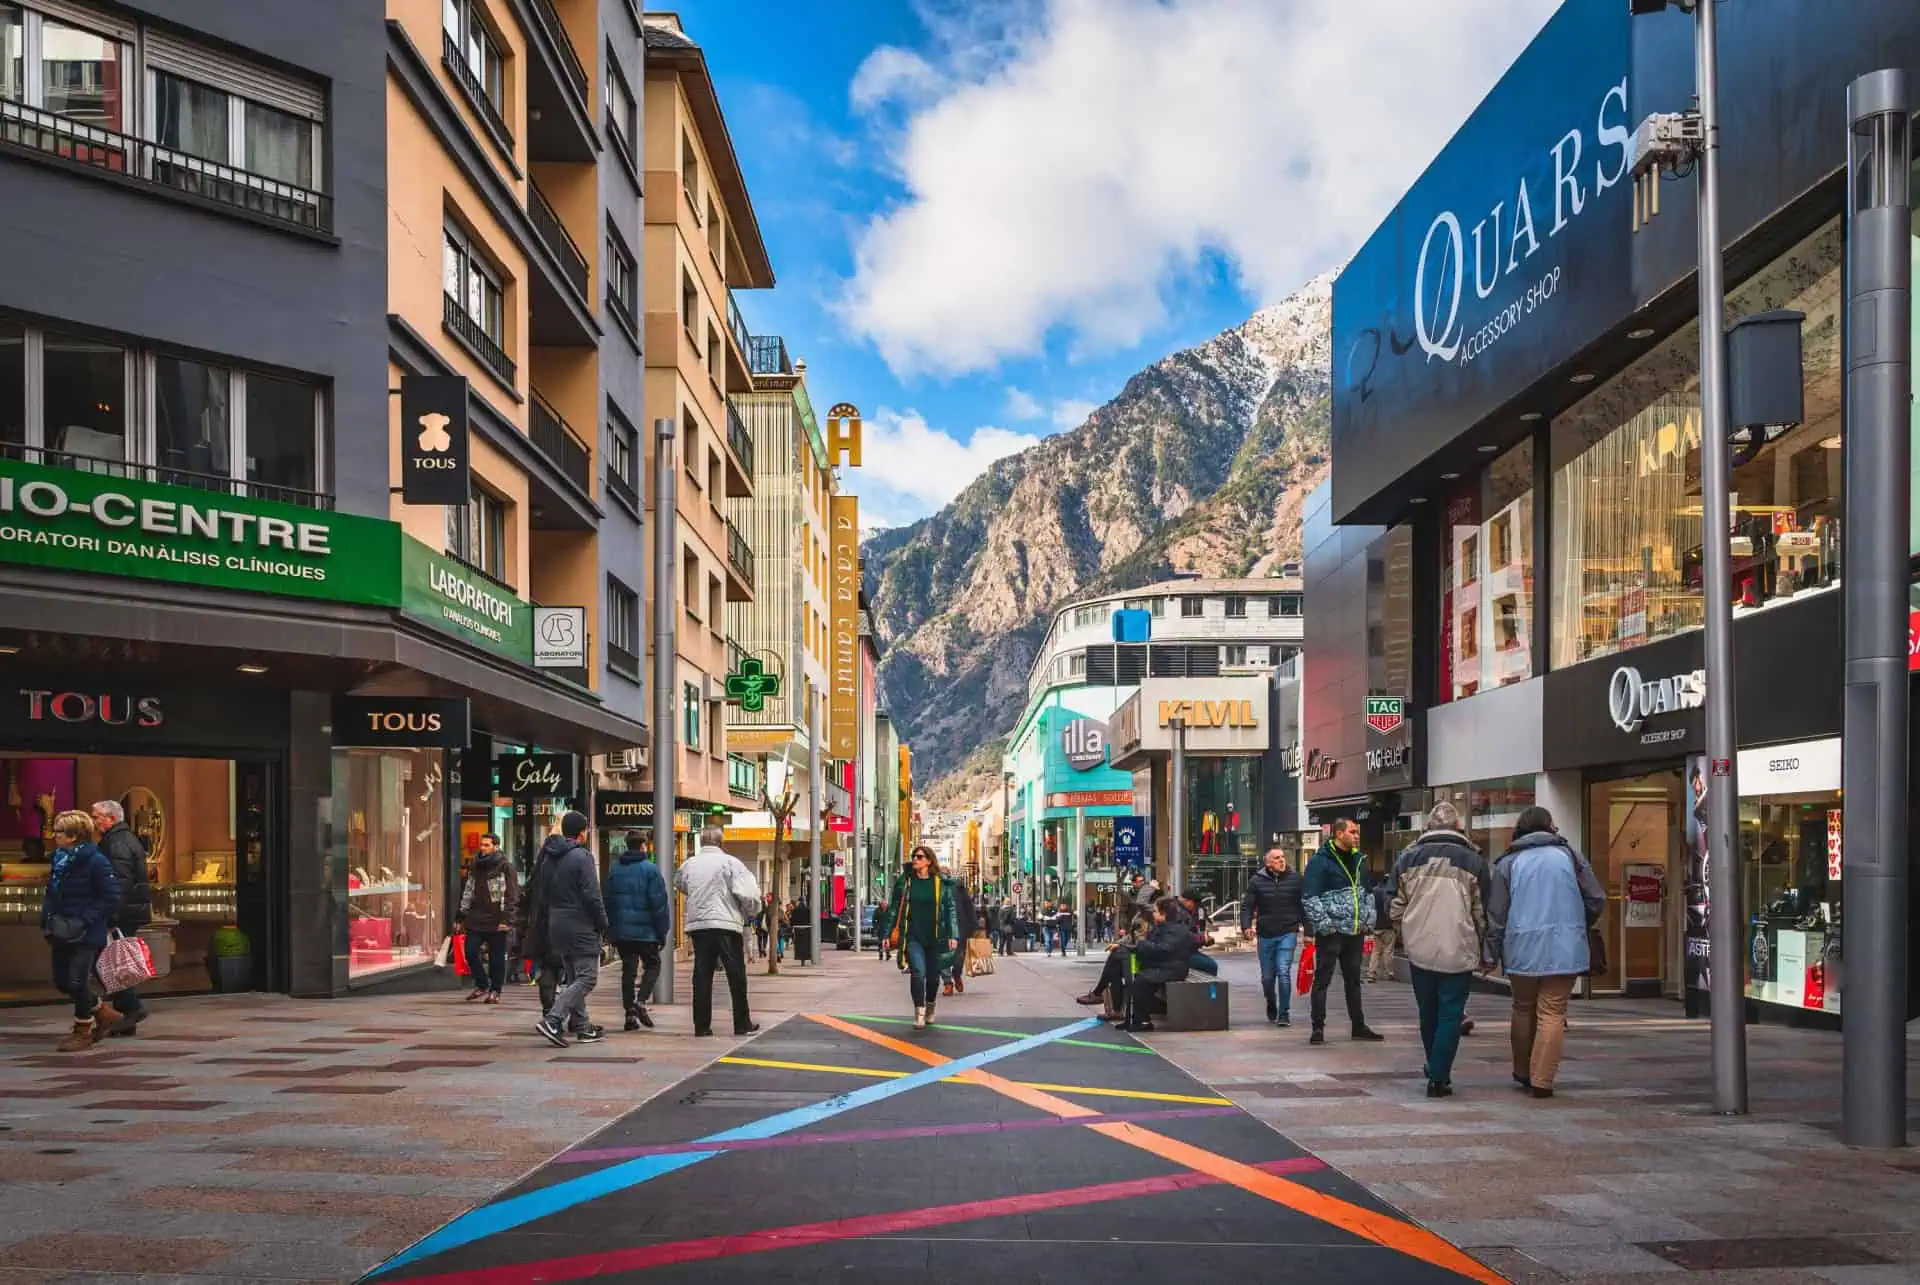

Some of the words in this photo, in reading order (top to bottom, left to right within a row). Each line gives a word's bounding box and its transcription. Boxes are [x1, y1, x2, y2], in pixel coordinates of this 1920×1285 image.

[1414, 76, 1628, 365] QUARS
[1460, 297, 1523, 367] ACCESSORY
[1526, 266, 1561, 313] SHOP
[412, 457, 457, 470] TOUS
[0, 477, 331, 554] IO-CENTRE
[837, 544, 853, 601] casa
[430, 561, 512, 628] LABORATORI
[19, 688, 164, 727] TOUS
[367, 712, 442, 731] TOUS
[1369, 714, 1399, 730] HEUER
[1370, 700, 1399, 713] TAG
[1064, 719, 1102, 754] illa
[512, 759, 562, 793] Galy
[1769, 757, 1800, 772] SEIKO
[605, 803, 654, 816] LOTTUSS
